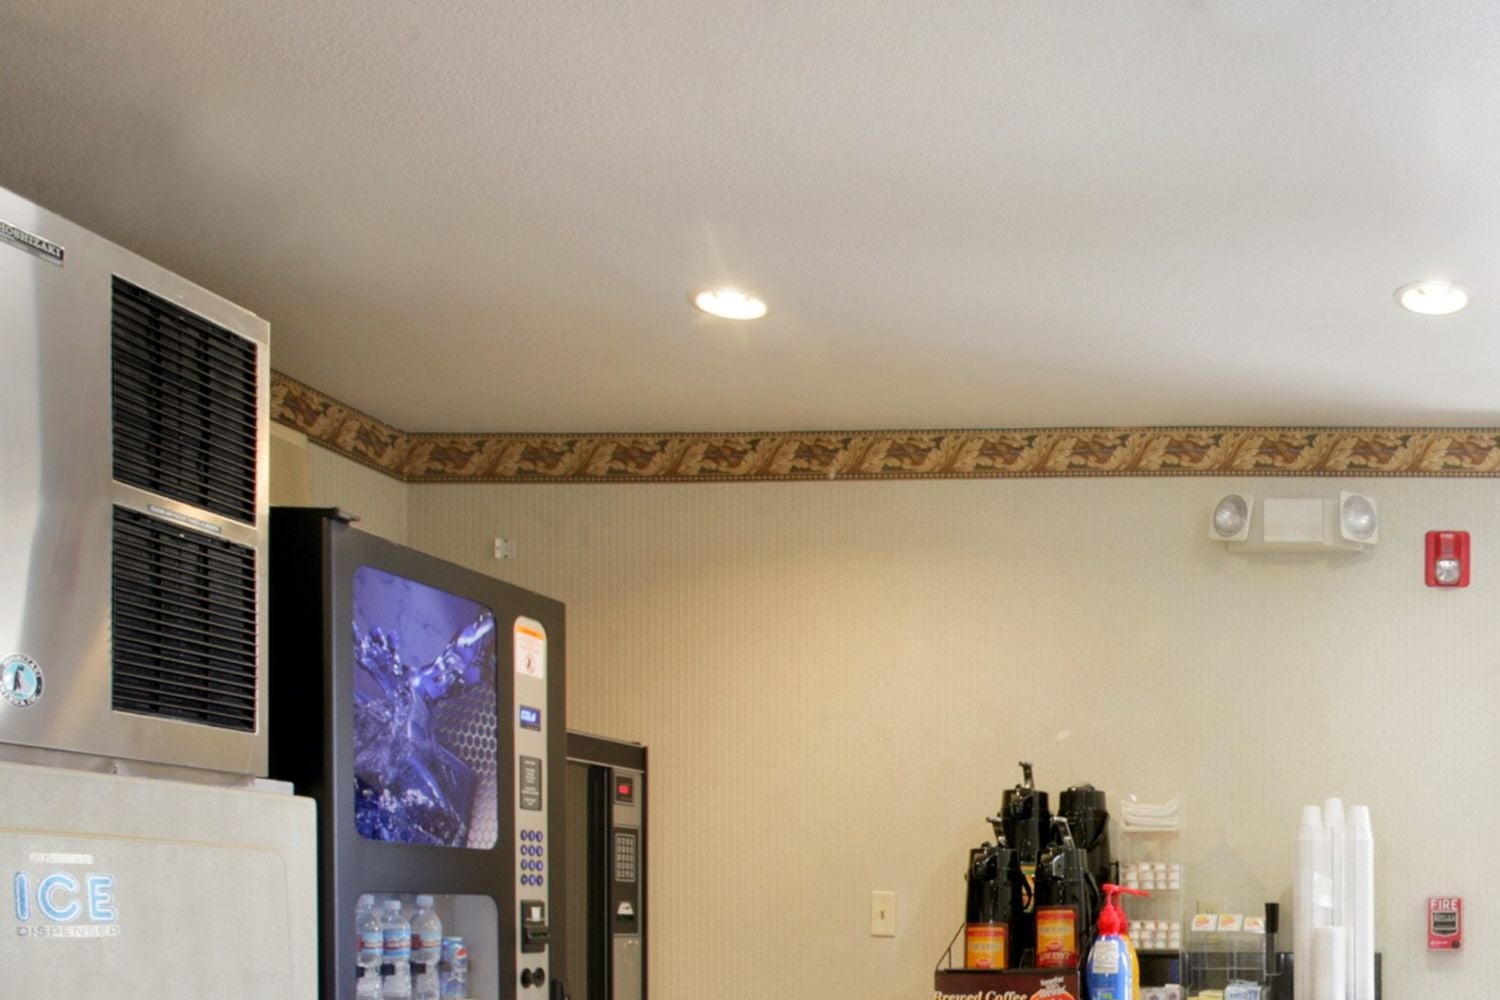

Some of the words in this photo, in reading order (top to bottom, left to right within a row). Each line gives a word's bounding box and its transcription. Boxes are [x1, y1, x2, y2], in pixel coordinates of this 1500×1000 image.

[14, 871, 117, 921] ICE
[1430, 899, 1458, 910] FIRE
[16, 925, 121, 938] DISPENSER
